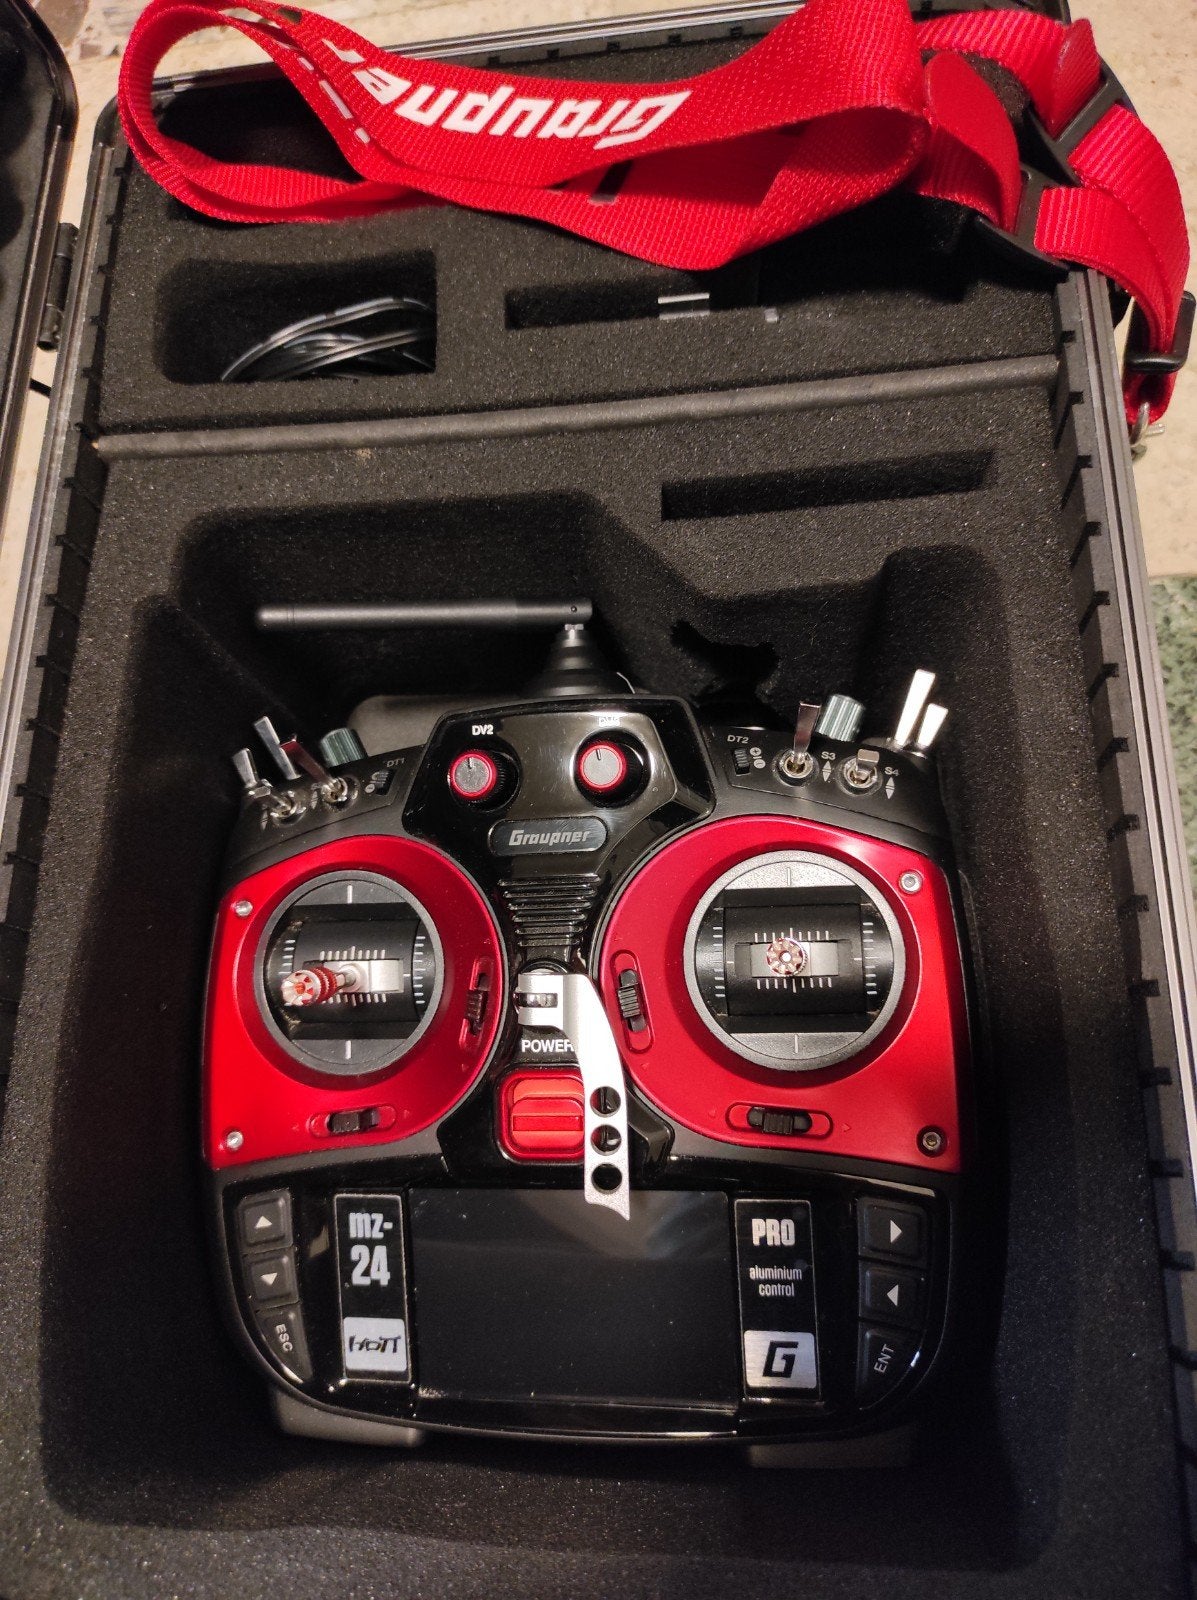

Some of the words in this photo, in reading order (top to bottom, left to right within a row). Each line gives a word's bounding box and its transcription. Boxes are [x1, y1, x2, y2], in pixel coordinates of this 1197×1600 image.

[321, 38, 692, 150] Graupner
[471, 724, 494, 736] DV2
[727, 734, 749, 745] DT2
[386, 757, 405, 768] DT1
[821, 751, 836, 761] S3
[884, 766, 900, 777] S4
[509, 829, 590, 846] Graupner
[521, 1039, 574, 1053] POWER
[751, 1218, 796, 1246] PRO
[350, 1244, 391, 1286] 24
[749, 1264, 803, 1281] aluminium
[758, 1282, 795, 1298] control
[762, 1339, 799, 1379] G
[873, 1343, 896, 1375] ENT
